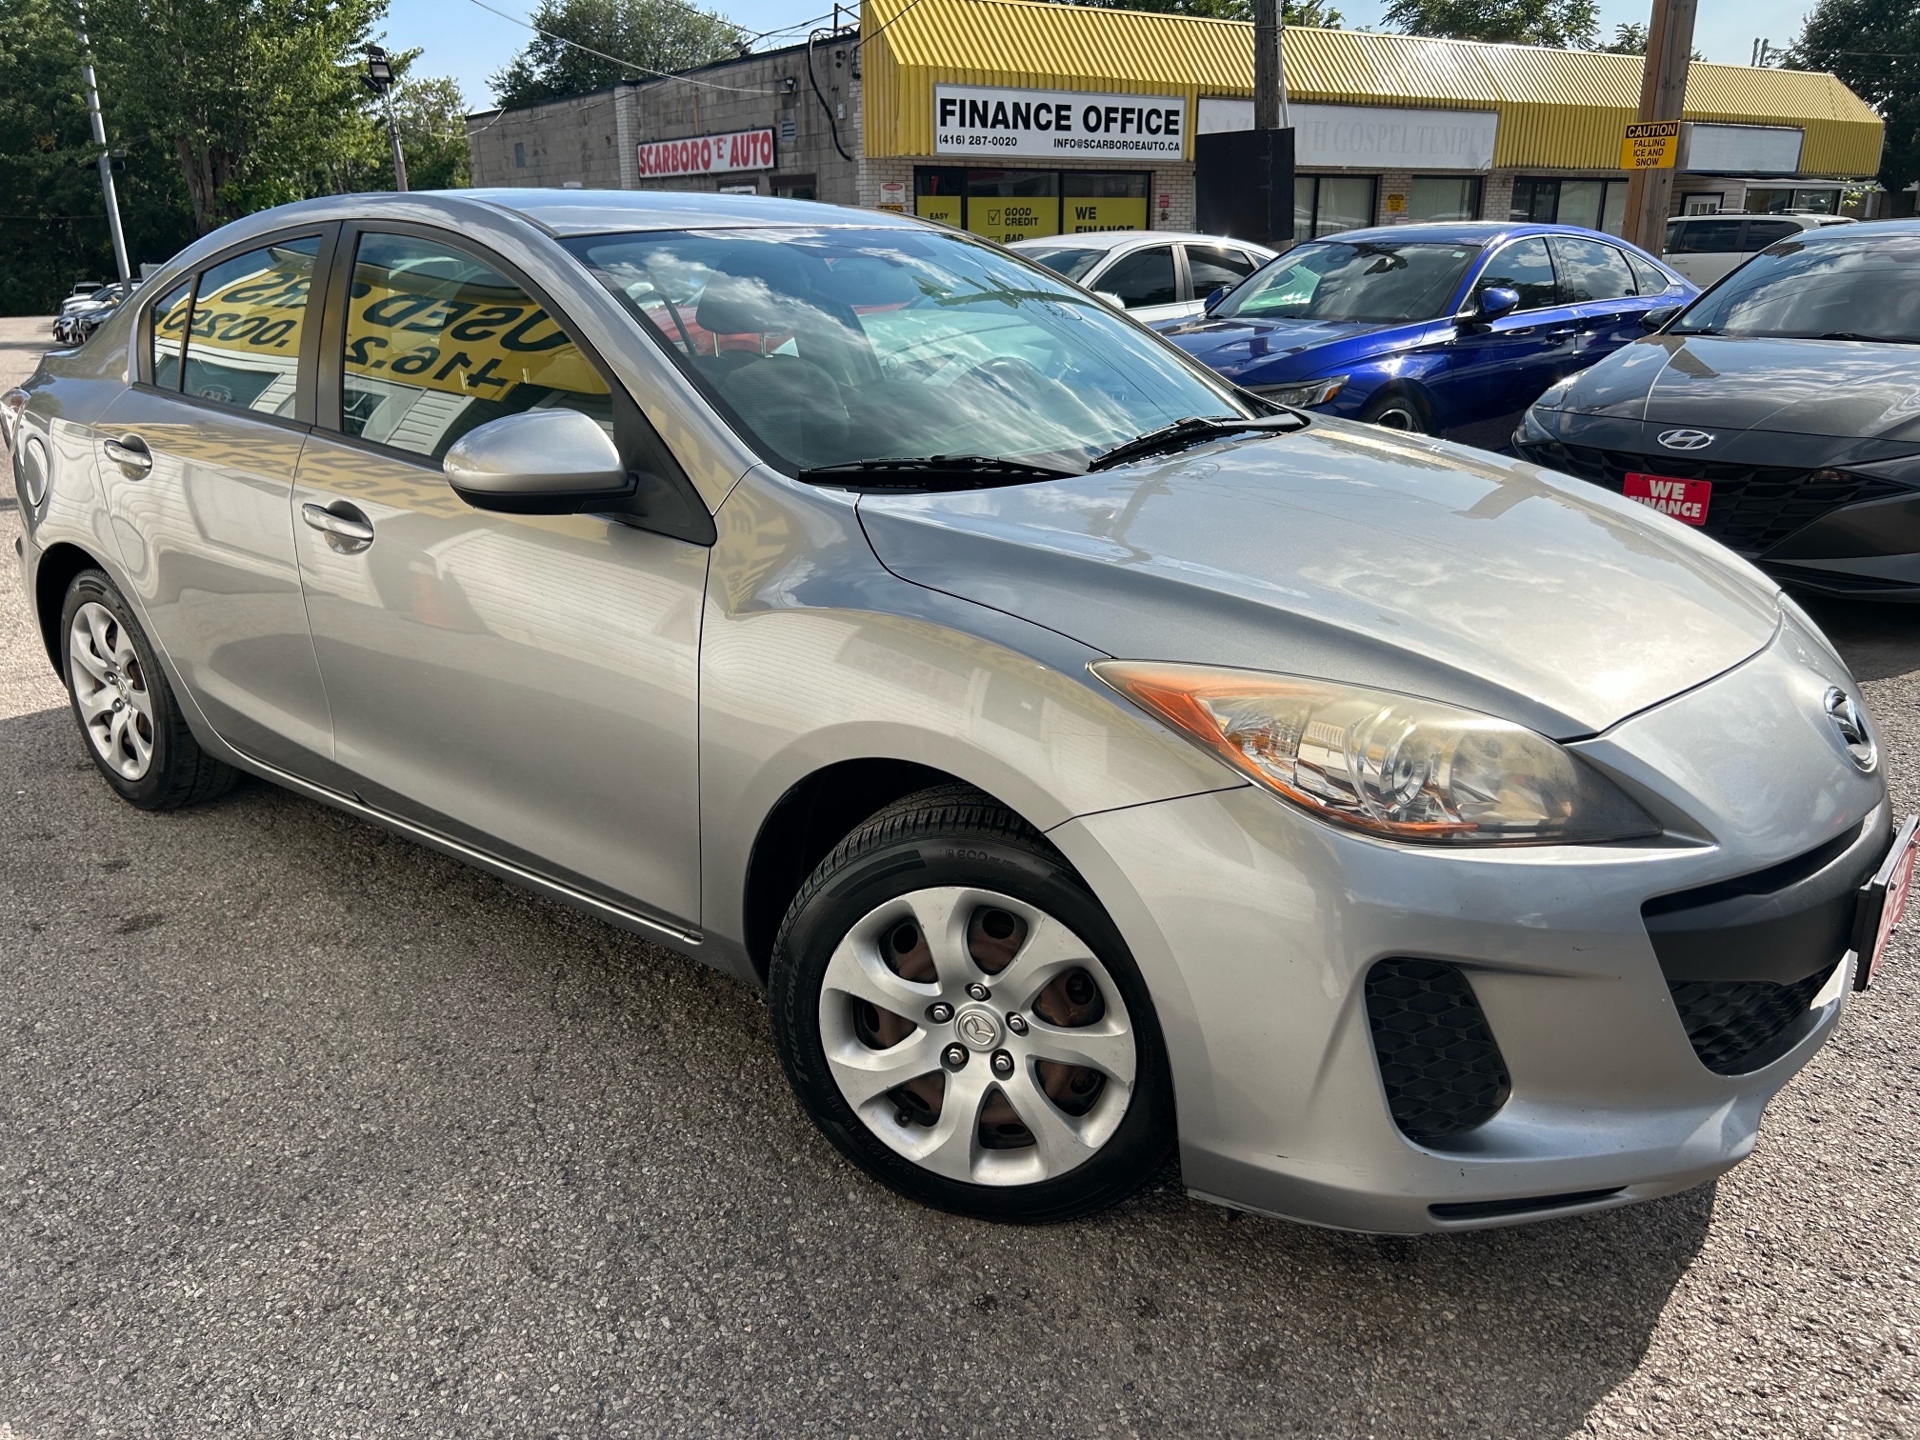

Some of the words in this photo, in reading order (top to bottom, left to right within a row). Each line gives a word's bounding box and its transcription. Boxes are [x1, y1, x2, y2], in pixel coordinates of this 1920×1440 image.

[939, 98, 1072, 132] FINANCE
[1082, 105, 1180, 136] OFFICE
[1627, 124, 1676, 137] CAUTION
[938, 134, 965, 146] (416)
[968, 136, 1018, 147] 287-0020
[1053, 137, 1180, 152] INFO@SCARBOROEAUTO.CA
[1333, 122, 1411, 154] GOSPEL
[1417, 125, 1491, 156] TEMPLE
[1633, 138, 1666, 148] FALLING
[639, 138, 711, 176] SCARBORO
[729, 131, 772, 168] AUTO
[1632, 149, 1646, 157] ICE
[1647, 148, 1664, 157] AND
[1635, 157, 1659, 167] SNOW
[929, 212, 949, 220] EASY
[1004, 207, 1032, 217] GOOD
[1074, 206, 1097, 220] WE
[1004, 217, 1039, 227] CREDIT
[1004, 233, 1024, 243] BAD
[1649, 480, 1686, 500] WE
